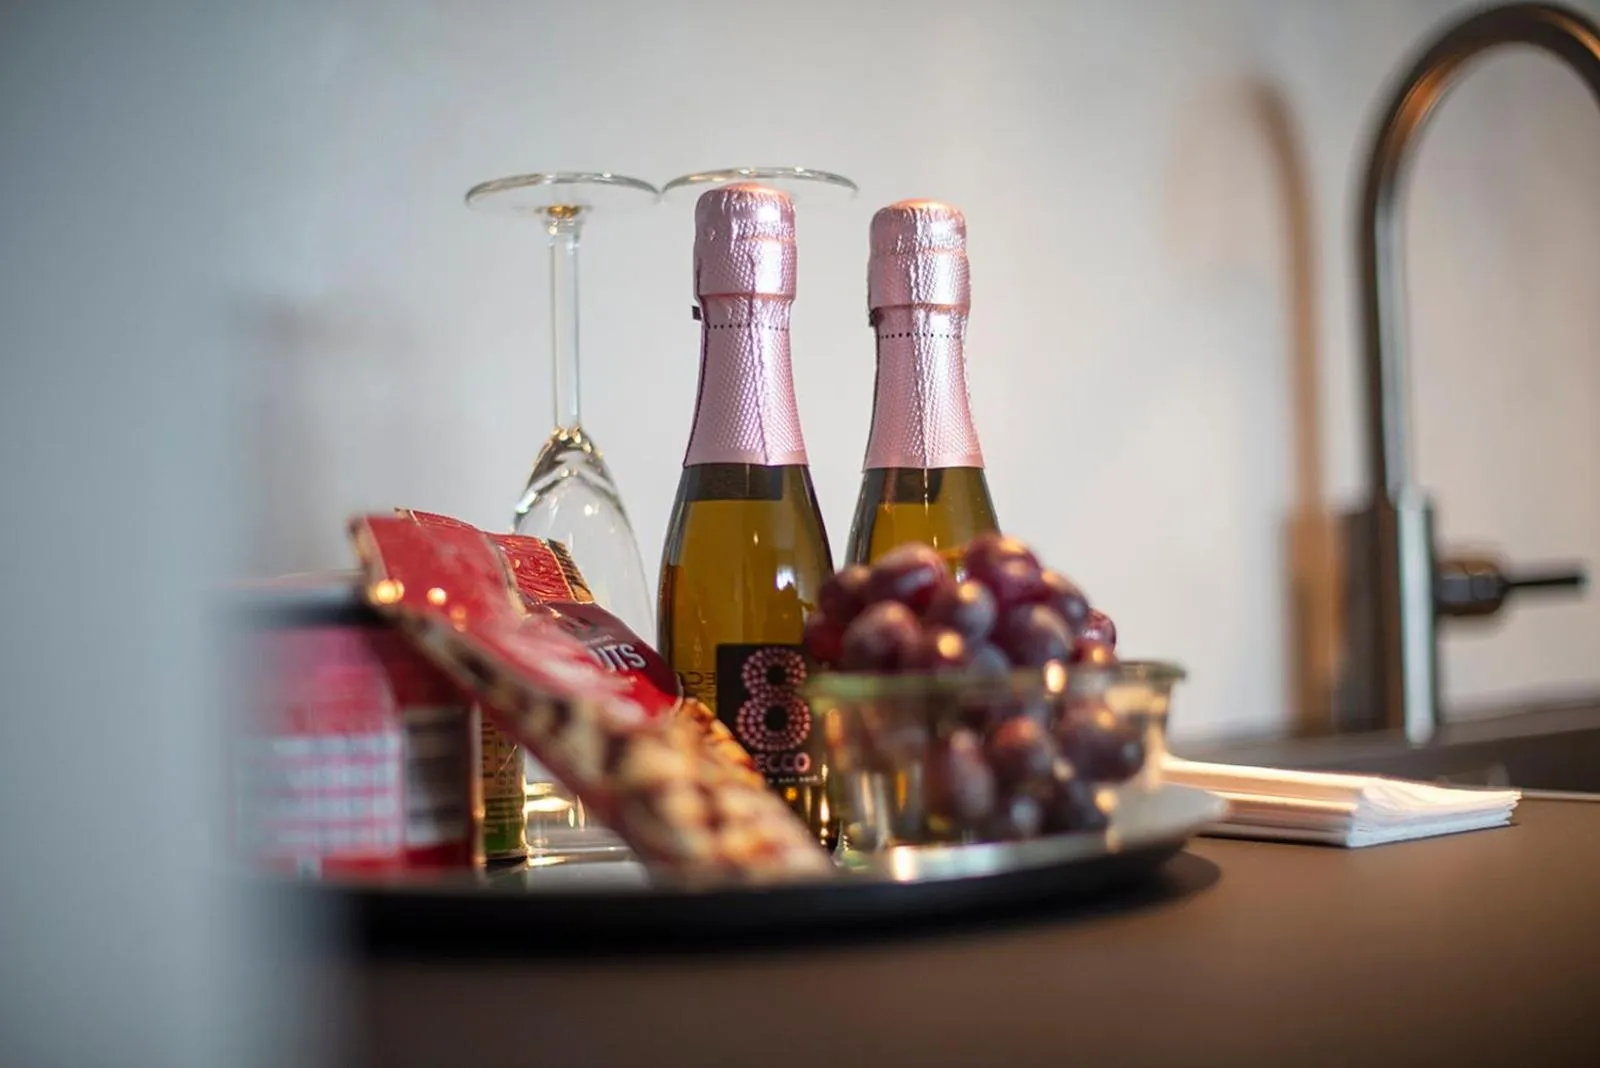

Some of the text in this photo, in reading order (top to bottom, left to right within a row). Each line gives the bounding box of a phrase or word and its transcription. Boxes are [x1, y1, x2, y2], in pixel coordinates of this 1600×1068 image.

[587, 643, 647, 673] UTS
[735, 646, 812, 751] 8
[753, 752, 811, 773] ECCO
